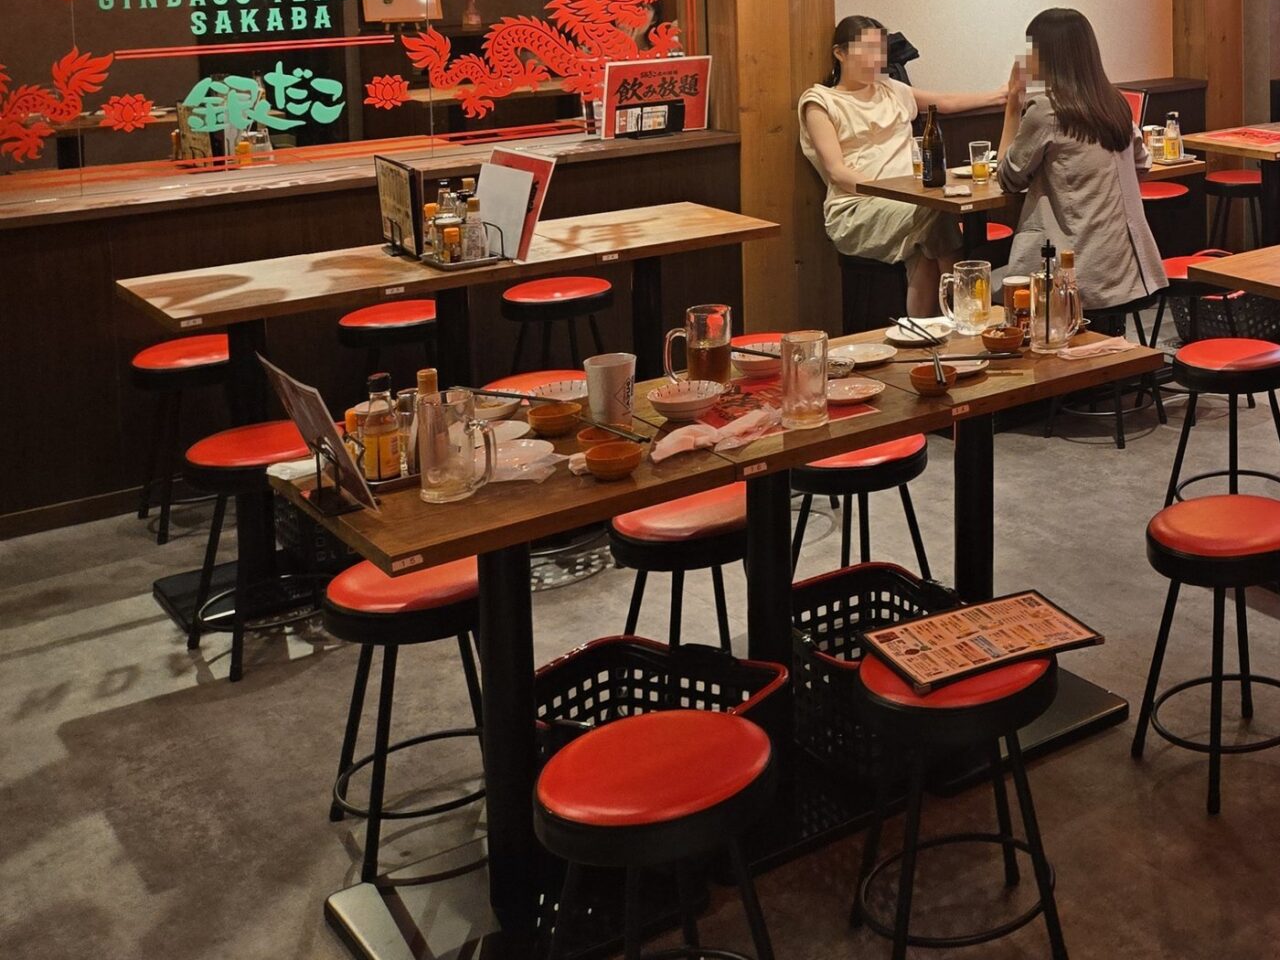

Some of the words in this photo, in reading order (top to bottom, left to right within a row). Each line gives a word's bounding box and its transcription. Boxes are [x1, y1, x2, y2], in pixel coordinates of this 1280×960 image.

[190, 5, 332, 36] SAKABA
[182, 60, 346, 133] 銀だこ
[615, 73, 700, 104] 飲み放題
